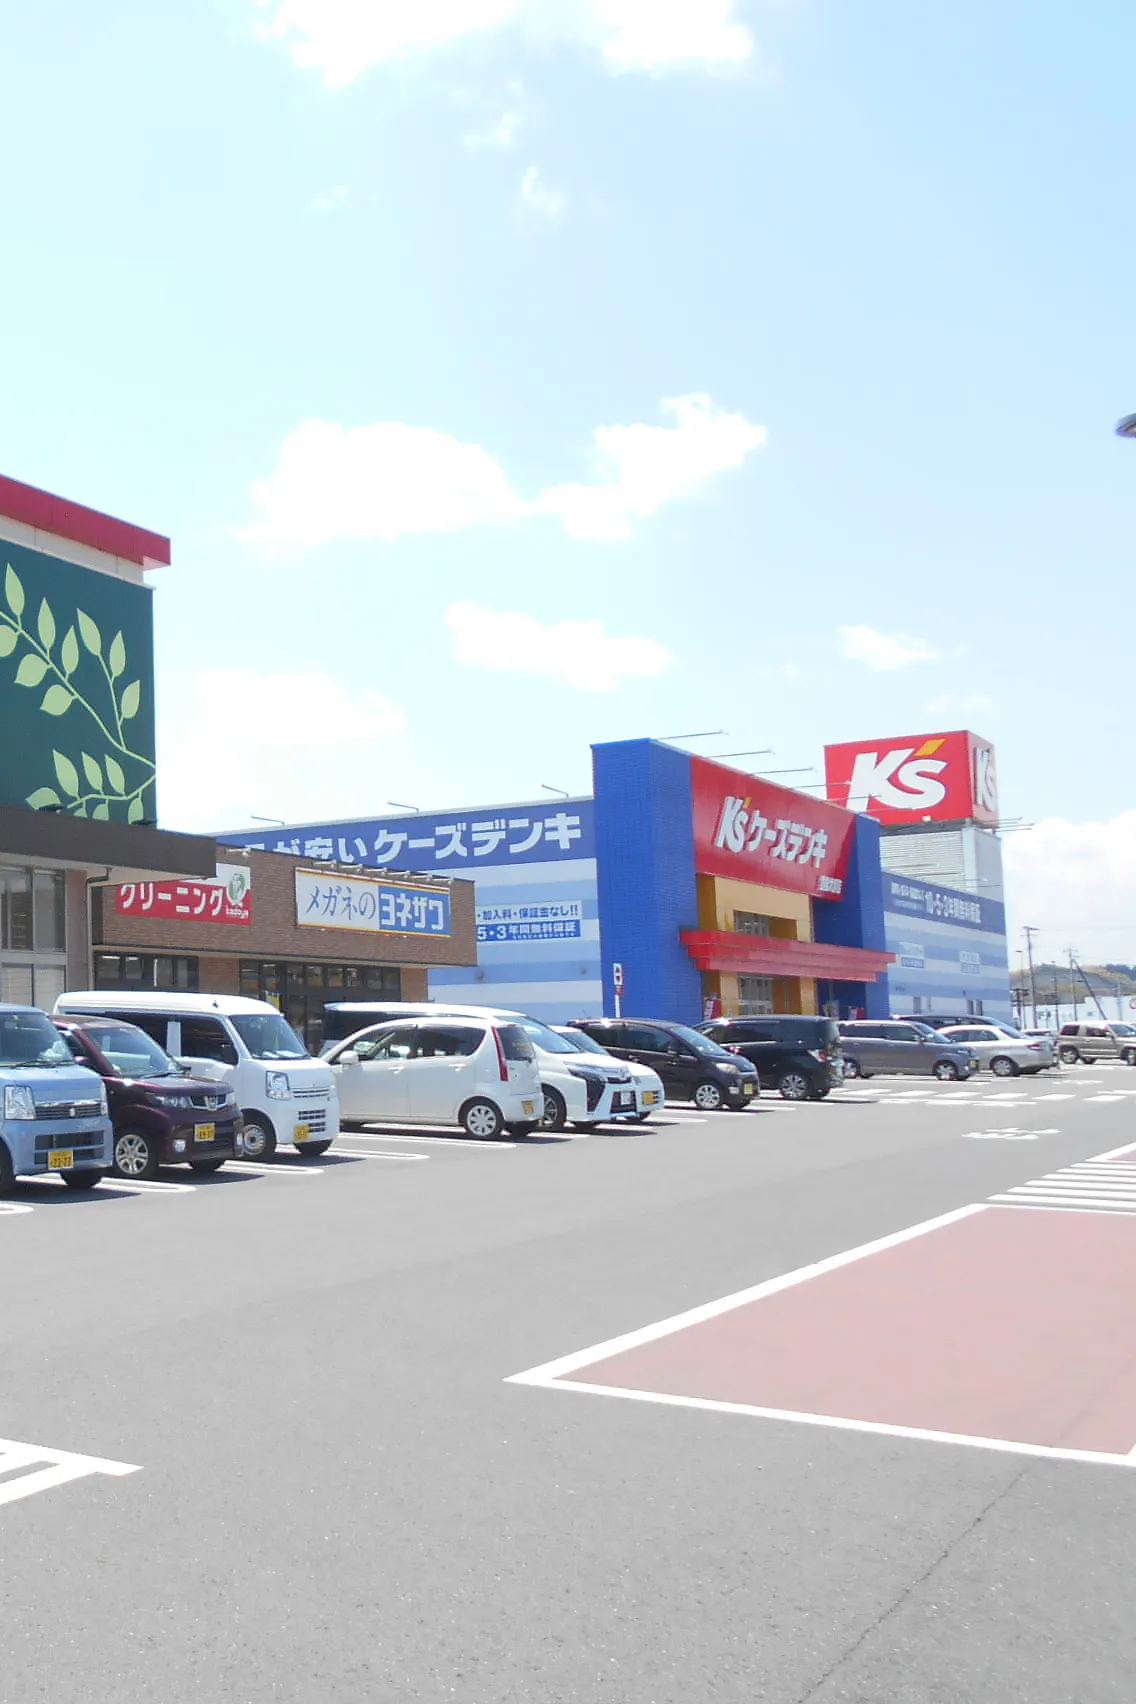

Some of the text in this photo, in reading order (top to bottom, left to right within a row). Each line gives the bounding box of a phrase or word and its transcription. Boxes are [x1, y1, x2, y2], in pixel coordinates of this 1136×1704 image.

[846, 739, 949, 812] K's
[120, 881, 224, 916] クリーニング
